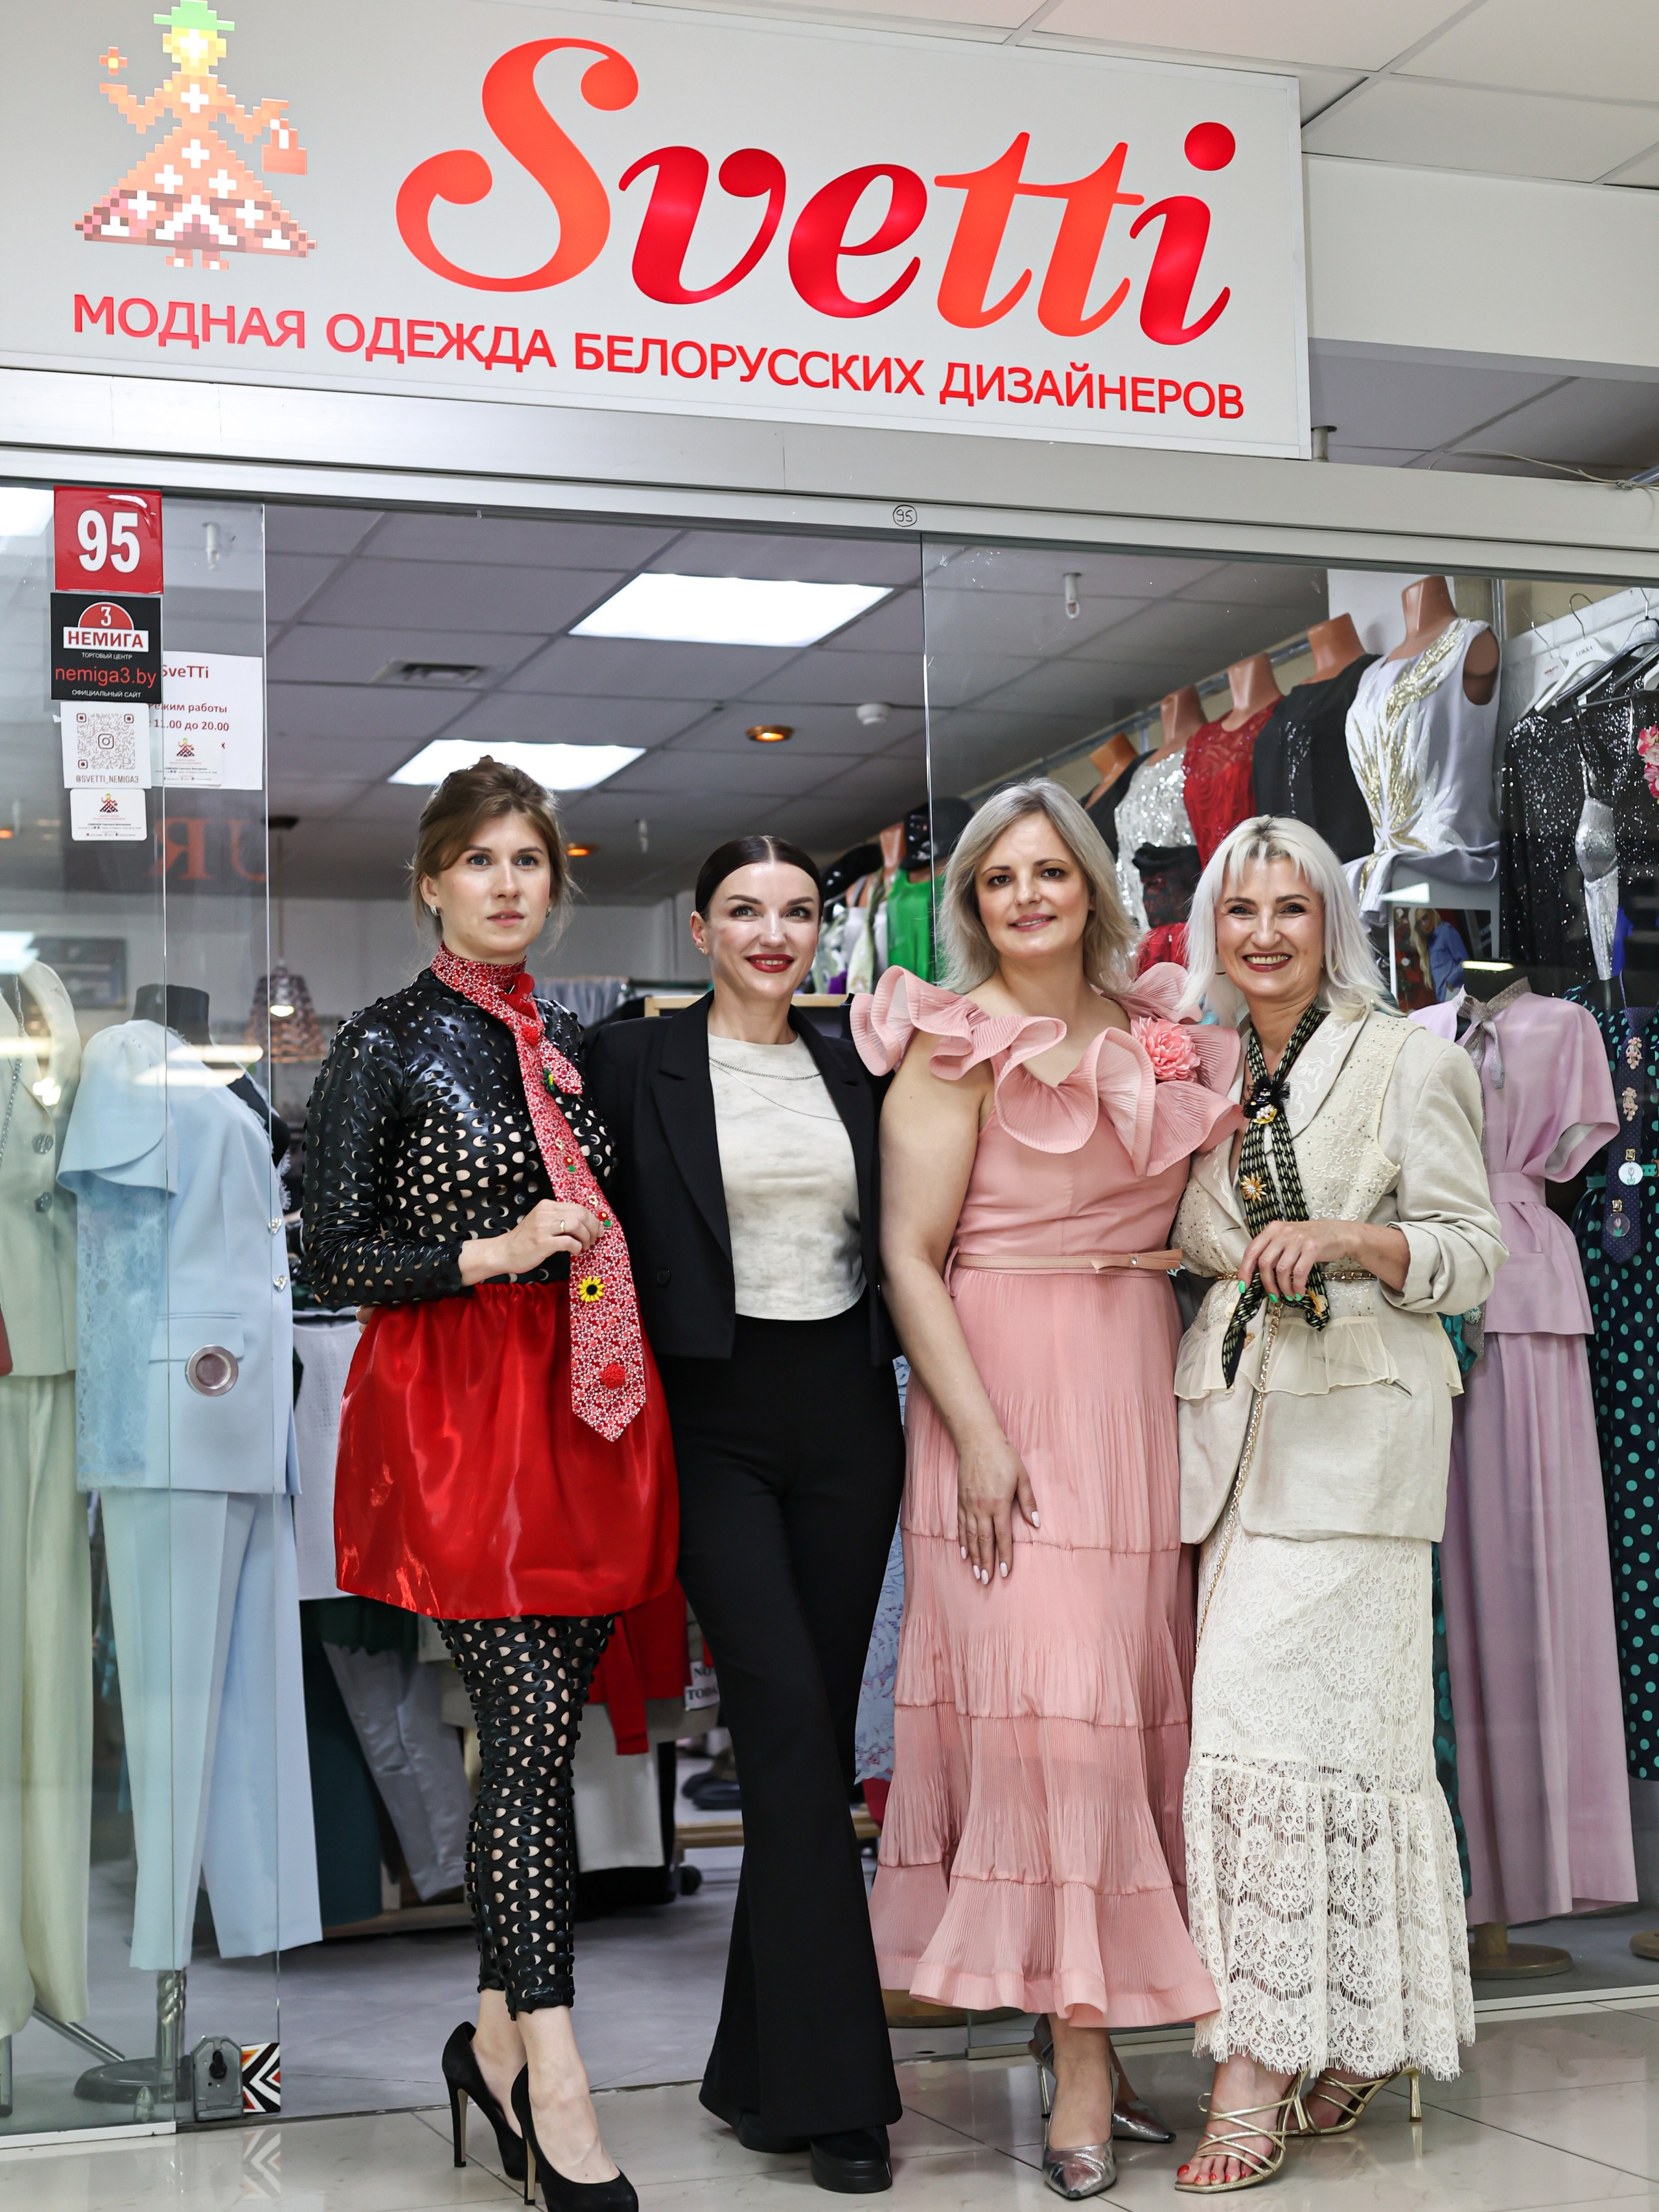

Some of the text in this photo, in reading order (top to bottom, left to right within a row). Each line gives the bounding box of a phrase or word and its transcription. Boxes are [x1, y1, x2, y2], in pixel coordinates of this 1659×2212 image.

[395, 37, 1236, 345] Svetti
[74, 294, 1244, 419] МОДНАЯ ОДЕЖДА БЕЛОРУССКИХ ДИЗАЙНЕРОВ
[896, 509, 912, 522] 95
[77, 509, 141, 574] 95
[100, 606, 112, 627] 3
[68, 631, 144, 648] НЕМИГА
[55, 666, 157, 688] nemiga3.by
[71, 689, 123, 697] ОФИЦИАЛЬНЫЙ
[188, 703, 227, 713] работы
[184, 722, 198, 731] до
[201, 721, 229, 731] 20.00
[76, 774, 139, 784] @SVETTI_NEMIGA3
